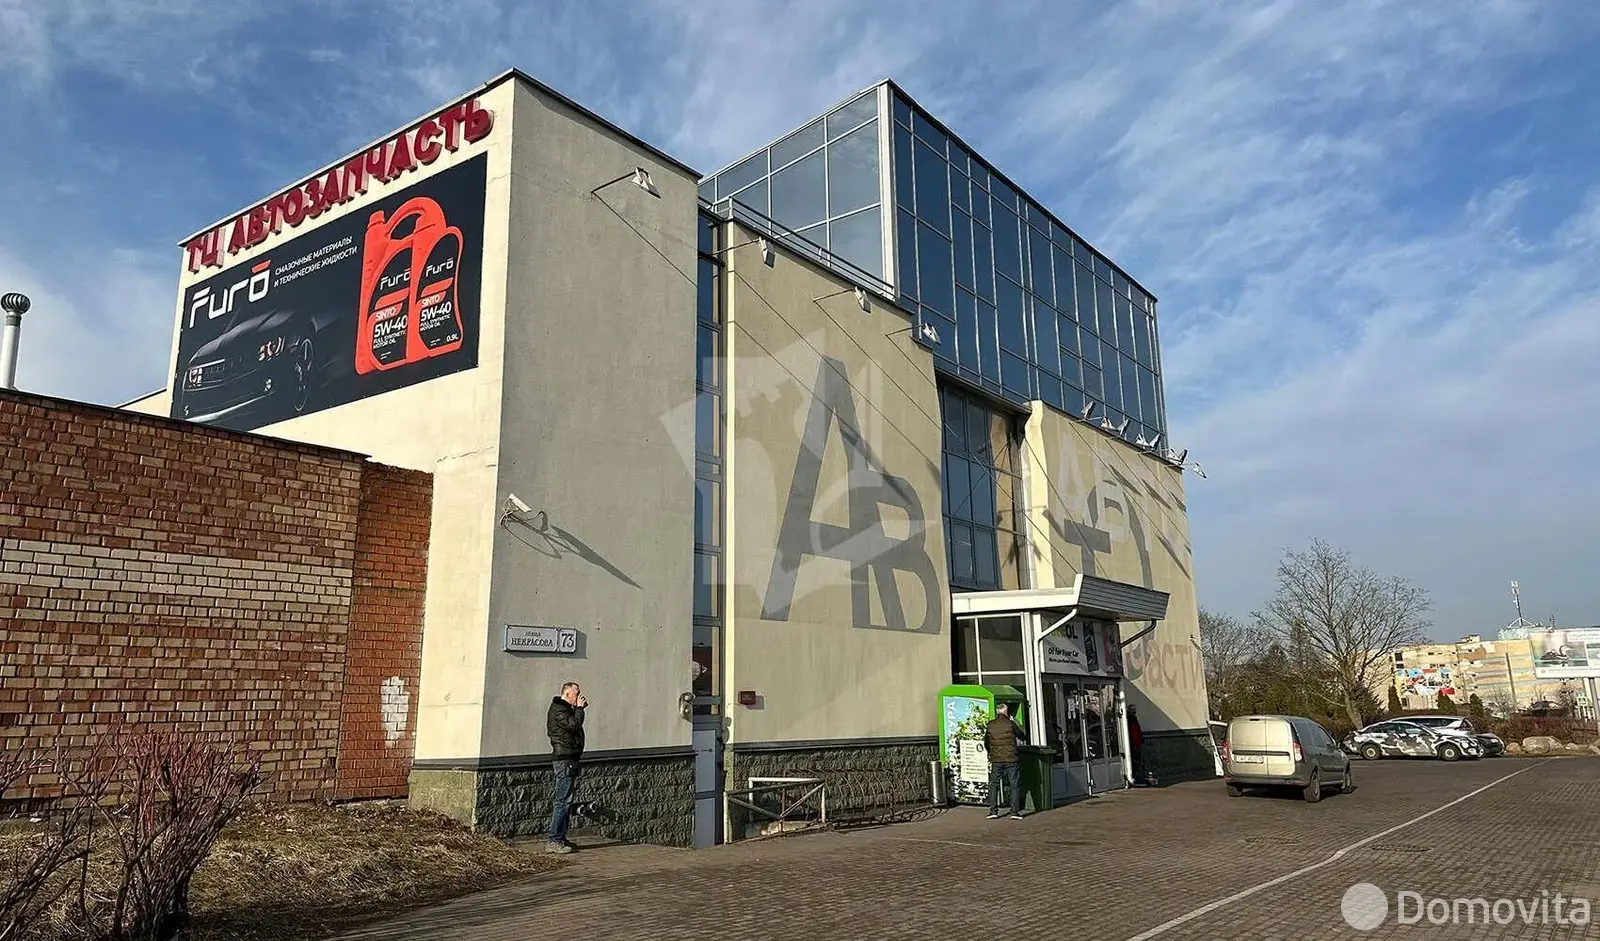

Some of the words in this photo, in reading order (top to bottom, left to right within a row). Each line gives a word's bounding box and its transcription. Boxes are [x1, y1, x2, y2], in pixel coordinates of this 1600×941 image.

[186, 228, 226, 275] ТЦ
[227, 99, 494, 256] АВТОЗАПЧАСТЬ
[274, 280, 279, 288] И
[280, 260, 321, 285] ТЕХНИЧЕСКИЕ
[321, 246, 357, 267] ЖИДКОСТИ
[275, 253, 313, 275] СМАЗОЧНЫЕ
[313, 236, 352, 259] МАТЕРИАЛЫ
[373, 315, 408, 338] 5W-40
[421, 302, 452, 322] 5W-40
[511, 637, 554, 648] НЕКРАСОВА
[562, 633, 575, 648] 73
